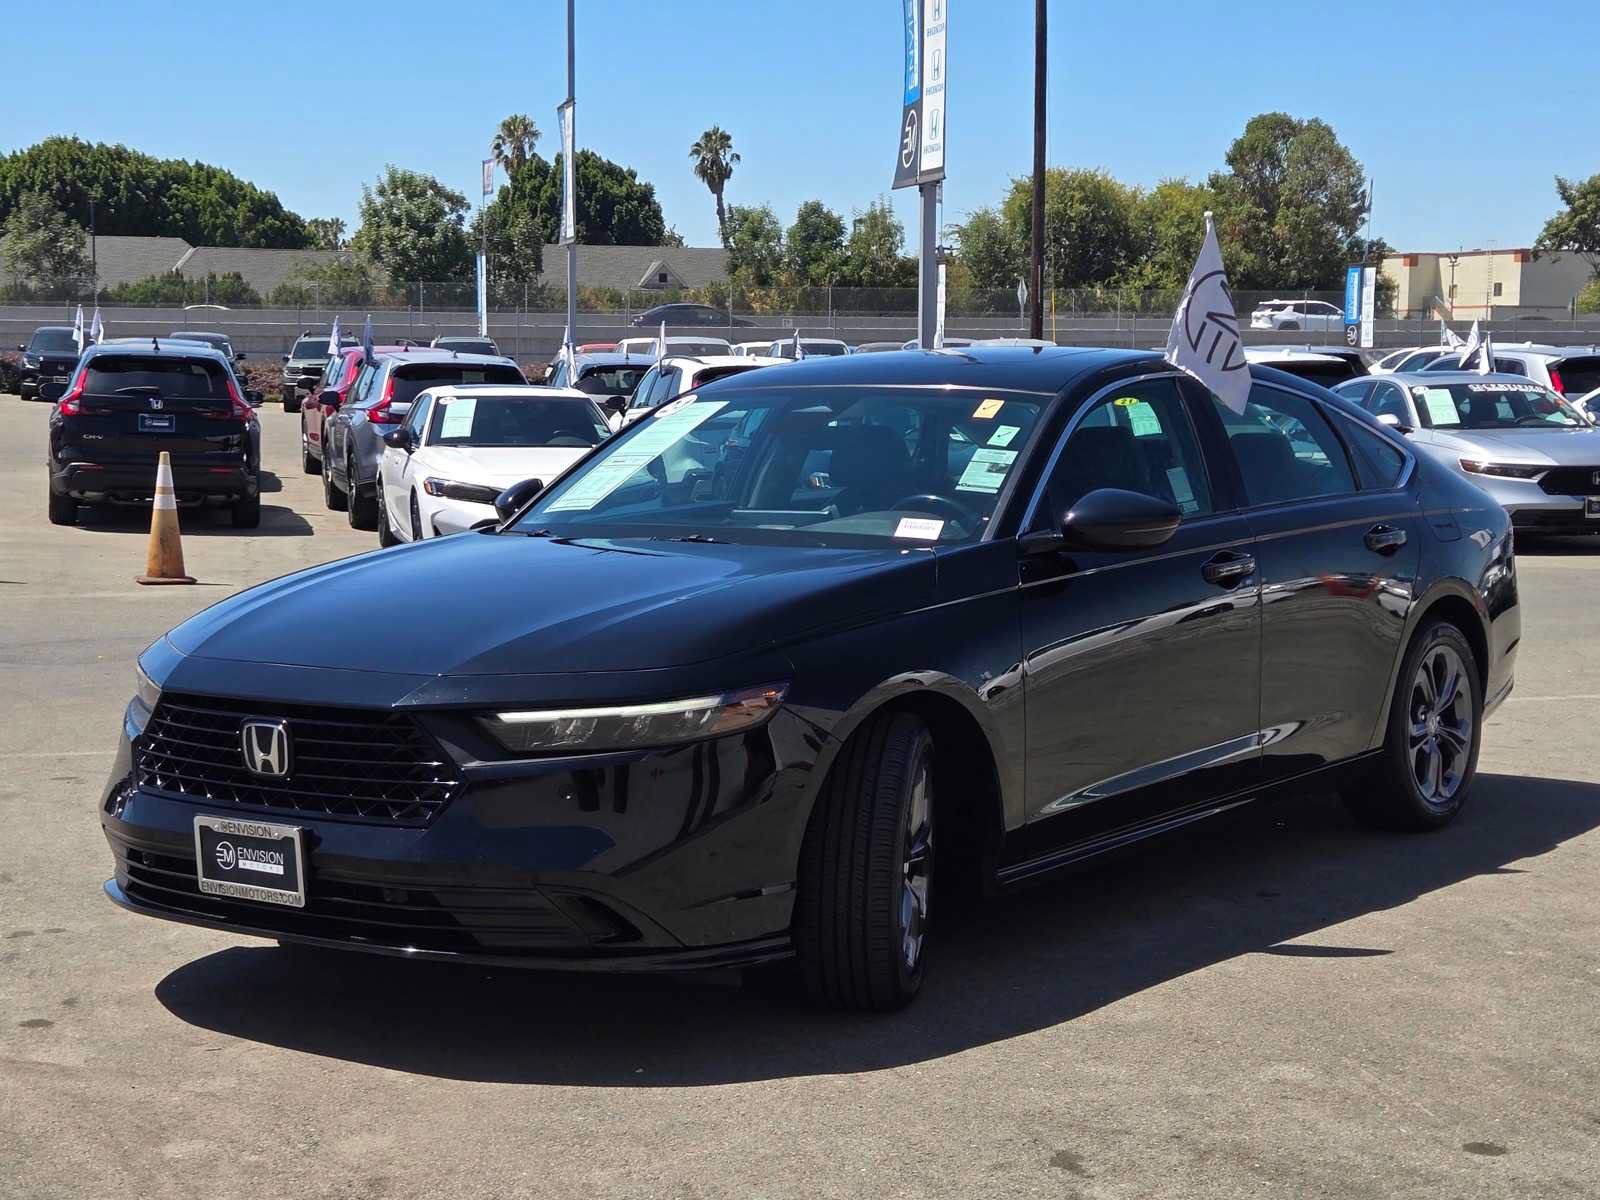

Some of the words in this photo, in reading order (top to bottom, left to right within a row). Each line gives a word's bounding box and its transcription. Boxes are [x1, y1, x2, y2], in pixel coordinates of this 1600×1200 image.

[927, 23, 945, 37] HONDA
[925, 84, 943, 96] HONDA
[923, 144, 942, 154] HONDA
[228, 822, 272, 837] ENVISION
[237, 847, 284, 865] ENVISION
[201, 881, 302, 905] ENVISIONMOTORS.COM
